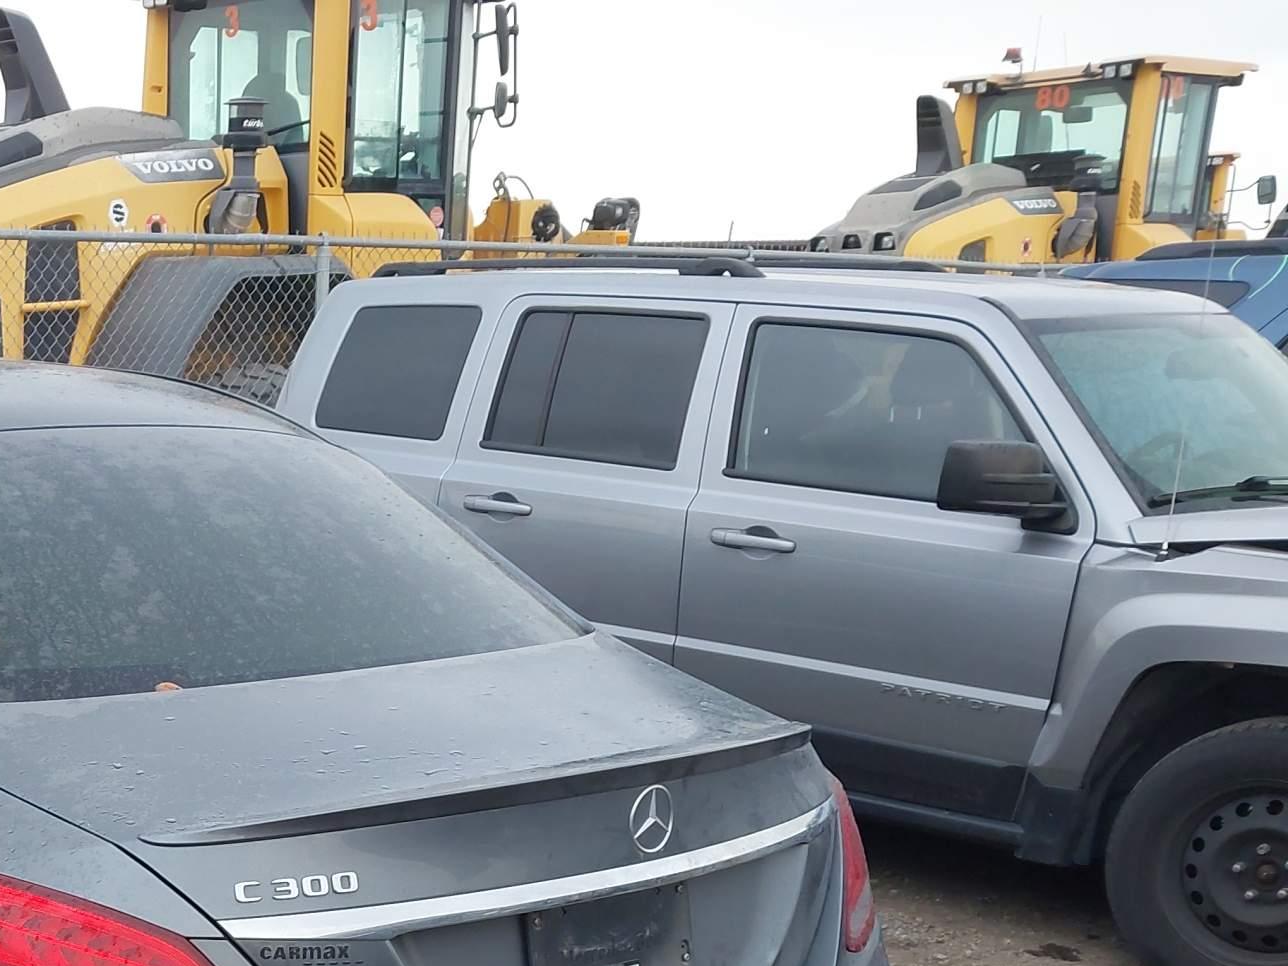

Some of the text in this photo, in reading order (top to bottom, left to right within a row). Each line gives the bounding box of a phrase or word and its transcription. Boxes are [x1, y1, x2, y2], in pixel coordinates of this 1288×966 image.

[1036, 84, 1070, 111] 80
[133, 157, 215, 175] VOLVO
[1012, 198, 1057, 210] VOLVO
[234, 870, 359, 903] C 300
